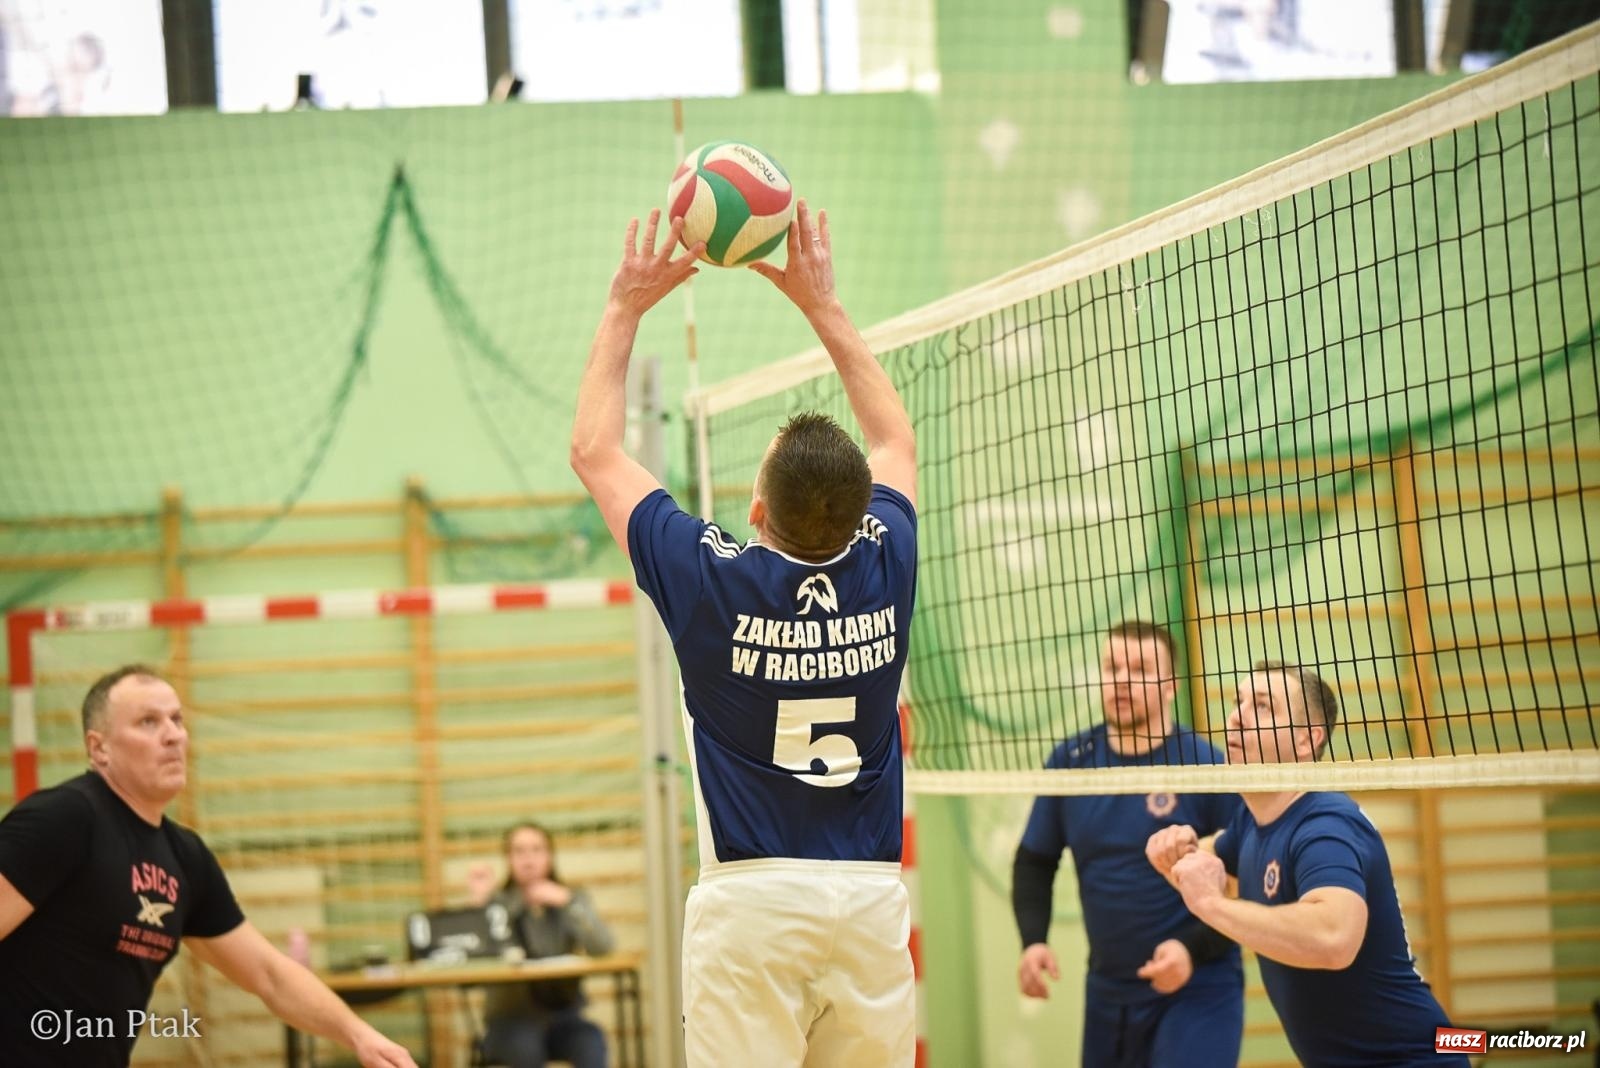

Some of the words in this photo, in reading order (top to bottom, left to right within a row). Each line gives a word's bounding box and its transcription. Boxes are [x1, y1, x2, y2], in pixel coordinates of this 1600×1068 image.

[734, 145, 776, 183] molten
[732, 614, 822, 648] ZAKŁAD
[826, 605, 896, 647] KARNY
[731, 646, 761, 677] W
[764, 635, 896, 681] RACIBORZU
[772, 696, 863, 788] 5
[131, 862, 179, 904] ASICS
